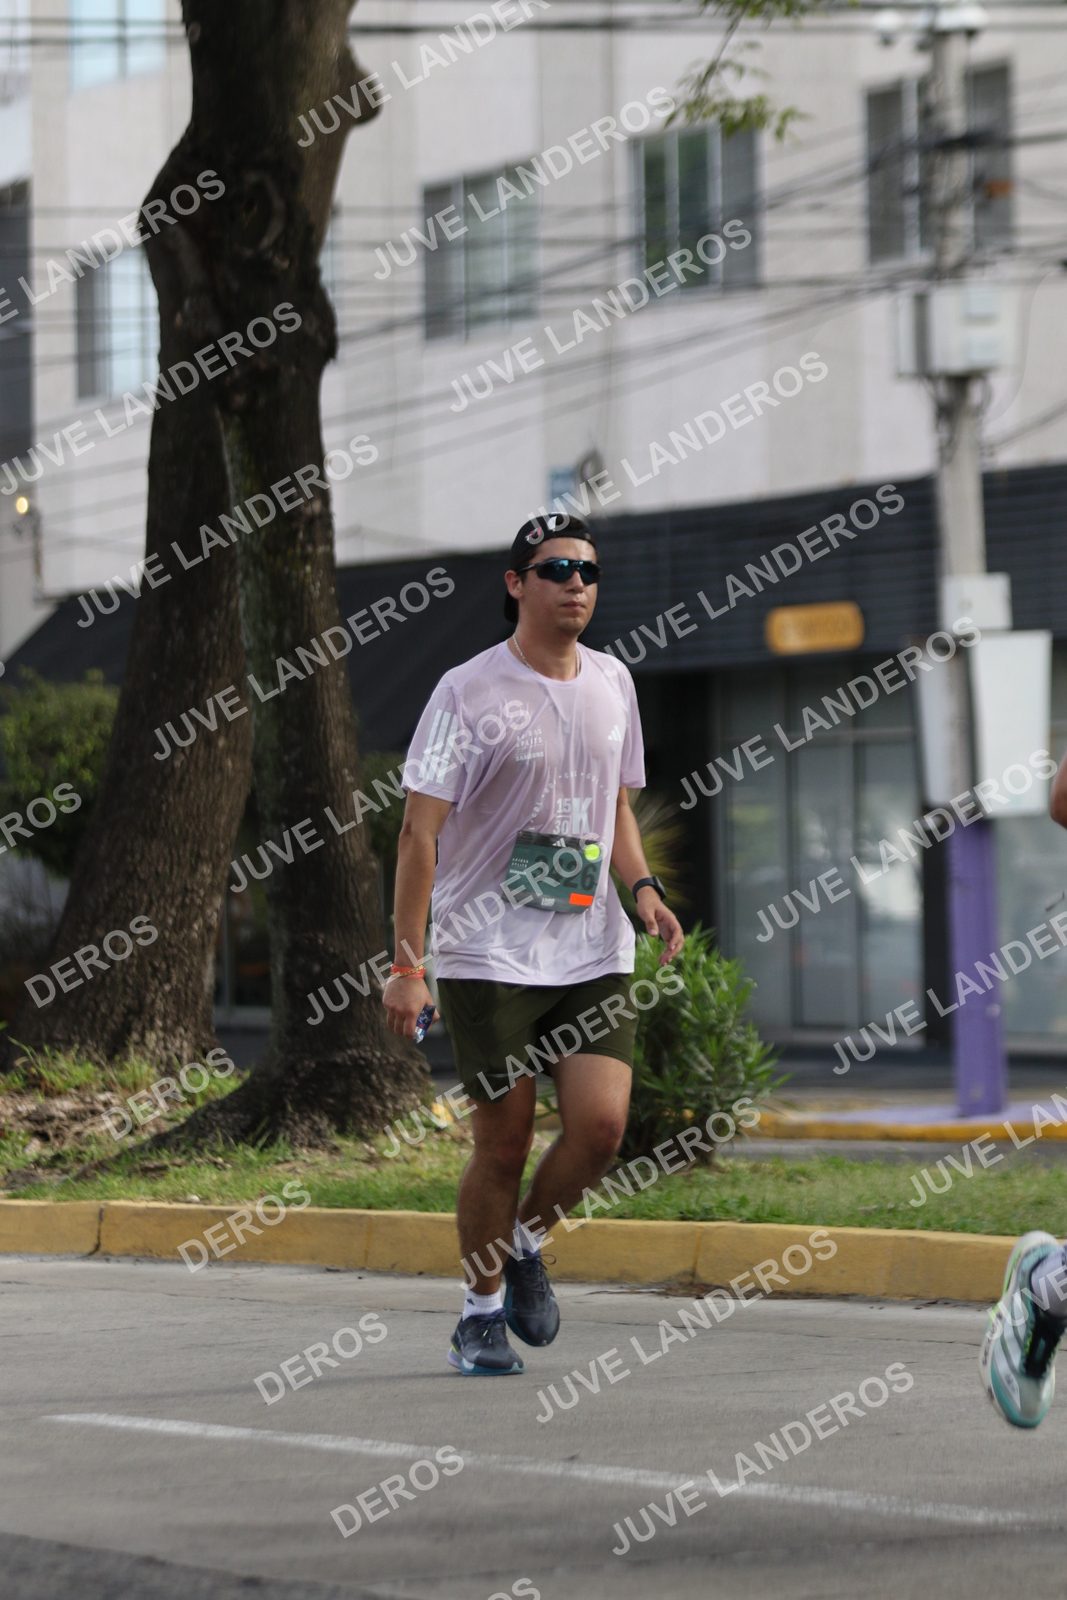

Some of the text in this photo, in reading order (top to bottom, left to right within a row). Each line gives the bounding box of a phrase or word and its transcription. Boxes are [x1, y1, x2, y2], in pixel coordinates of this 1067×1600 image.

[553, 820, 569, 835] 30
[556, 798, 571, 814] 15
[572, 797, 593, 834] K
